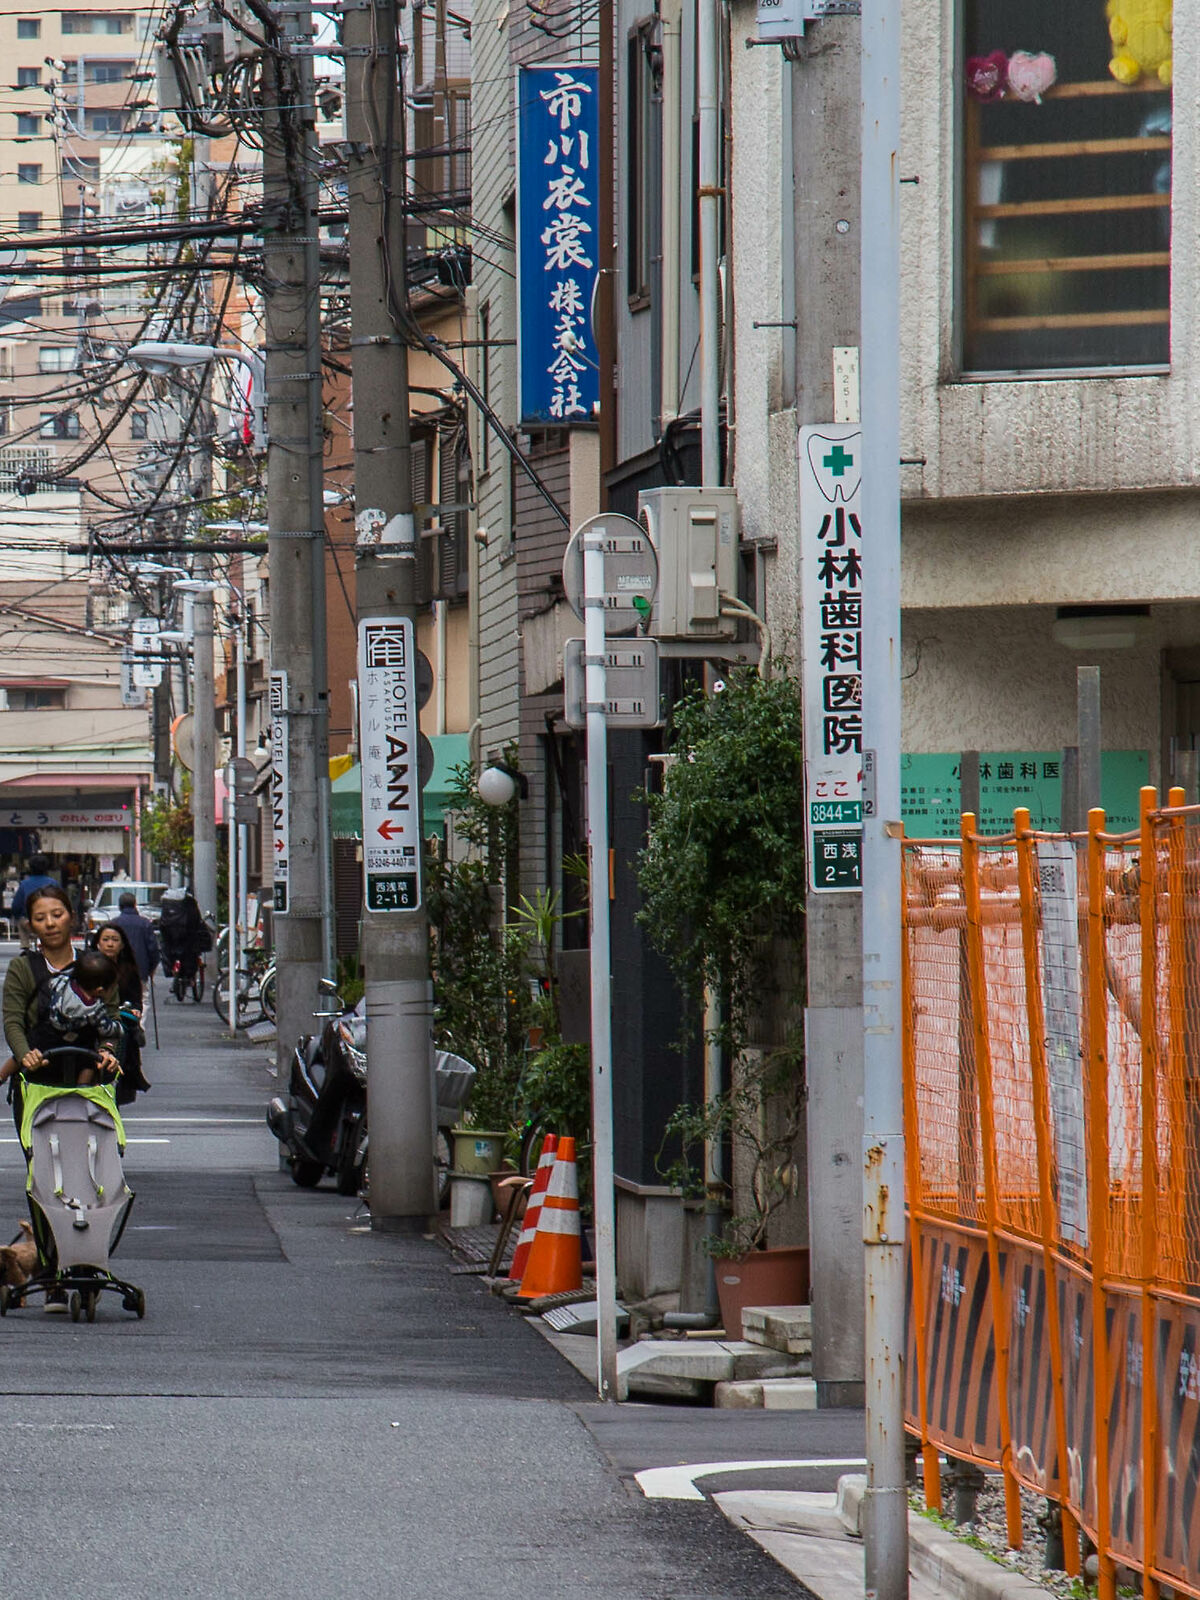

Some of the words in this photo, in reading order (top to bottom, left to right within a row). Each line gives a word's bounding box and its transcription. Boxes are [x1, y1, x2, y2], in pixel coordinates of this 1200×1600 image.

[818, 507, 862, 755] 小林歯科医院
[383, 671, 393, 731] ASAKUSA
[392, 671, 408, 733] HOTEL
[274, 714, 284, 763] HOTEL
[385, 734, 410, 811] ANN
[816, 782, 849, 797] ここ
[272, 768, 284, 830] ANN
[812, 804, 860, 821] 3844-1
[823, 843, 858, 859] 西浅
[825, 865, 859, 881] 2-1
[376, 893, 409, 905] 2-16
